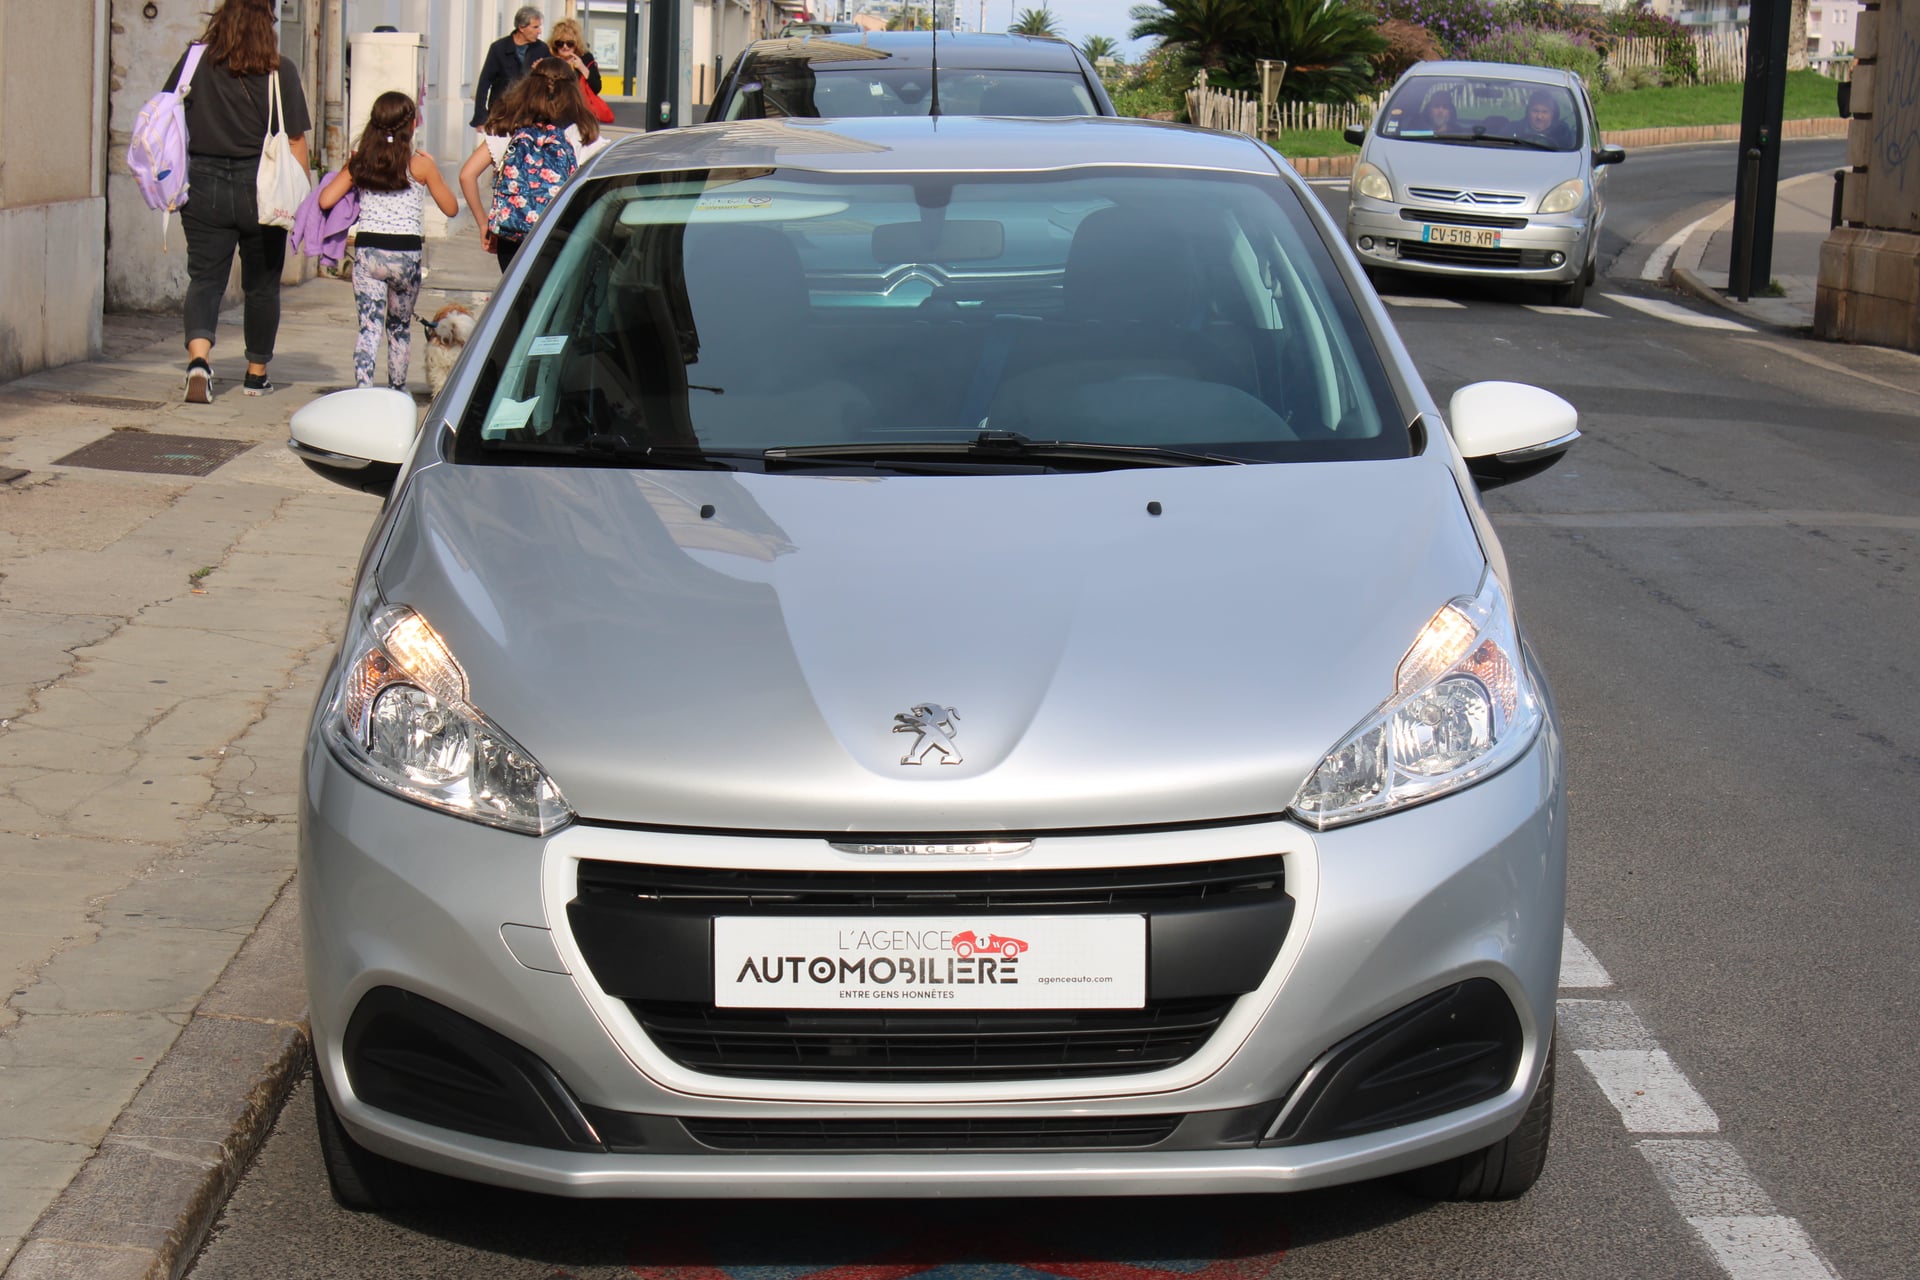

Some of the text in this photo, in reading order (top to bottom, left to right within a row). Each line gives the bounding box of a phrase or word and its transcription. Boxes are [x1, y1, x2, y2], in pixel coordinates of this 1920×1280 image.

[838, 930, 952, 951] L'AGENCE
[977, 936, 985, 947] 1
[1038, 975, 1113, 985] agenceauto.com
[839, 988, 955, 999] ENTRE GENS HONNÊTES
